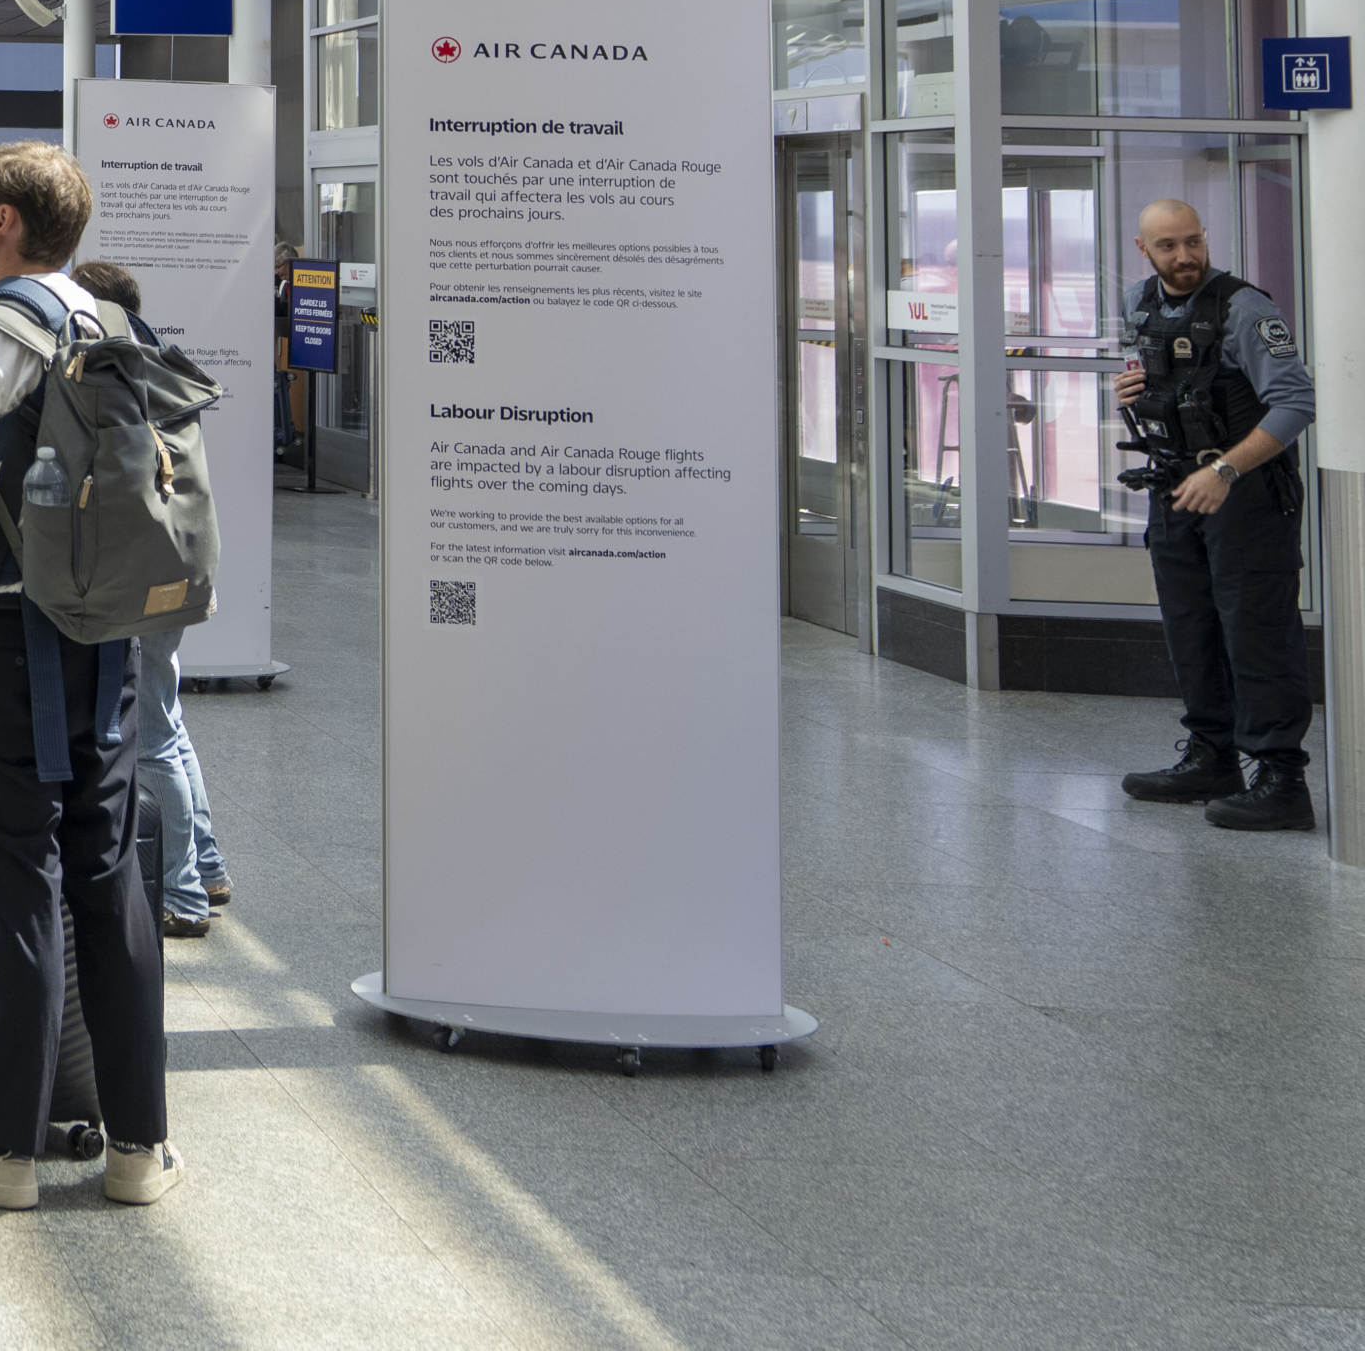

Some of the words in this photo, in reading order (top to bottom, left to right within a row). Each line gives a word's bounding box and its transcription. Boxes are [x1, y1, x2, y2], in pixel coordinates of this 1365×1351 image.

[474, 43, 521, 58] AIR
[531, 44, 647, 61] CANADA
[126, 117, 150, 126] AIR
[155, 118, 215, 129] CANADA
[430, 118, 536, 136] Interruption
[542, 120, 564, 134] de
[569, 121, 623, 135] travail
[102, 160, 158, 171] Interruption
[161, 162, 172, 170] de
[175, 163, 202, 171] travail
[430, 155, 453, 166] Les
[458, 156, 484, 167] vols
[489, 156, 518, 168] d'Air
[523, 157, 573, 169] Canada
[578, 159, 591, 169] et
[596, 158, 624, 170] d'Air
[629, 160, 676, 171] Canada
[682, 161, 721, 175] Rouge
[430, 174, 459, 183] sont
[464, 173, 517, 185] touchés
[523, 176, 544, 188] par
[549, 177, 574, 186] une
[579, 175, 655, 190] interruption
[660, 177, 675, 188] de
[430, 189, 470, 200] travail
[476, 190, 496, 204] qui
[501, 190, 561, 203] affectera
[567, 192, 584, 203] les
[590, 193, 615, 204] vols
[619, 196, 635, 205] au
[640, 196, 674, 206] cours
[430, 206, 453, 217] des
[459, 207, 524, 220] prochains
[528, 208, 564, 222] jours.
[296, 273, 332, 285] ATTENTION
[294, 307, 312, 316] PORTES
[300, 298, 318, 307] GARDEZ
[319, 300, 327, 308] LES
[908, 301, 928, 321] YUL
[295, 325, 307, 333] KEEP
[307, 325, 315, 334] THE
[316, 326, 332, 336] DOORS
[304, 336, 322, 345] CLOSED
[431, 404, 495, 419] Labour
[501, 406, 593, 425] Disruption
[431, 441, 449, 453] Air
[454, 443, 505, 455] Canada
[510, 445, 535, 456] and
[541, 445, 559, 457] Air
[564, 447, 614, 459] Canada
[619, 448, 660, 463] Rouge
[665, 449, 704, 464] flights
[431, 461, 452, 470] are
[457, 459, 520, 474] impacted
[526, 462, 541, 476] by
[546, 465, 554, 474] a
[560, 464, 601, 476] labour
[606, 465, 670, 480] disruption
[675, 467, 730, 482] affecting
[431, 476, 473, 490] flights
[478, 480, 507, 490] over
[512, 479, 534, 491] the
[539, 481, 588, 496] coming
[593, 482, 626, 496] days.
